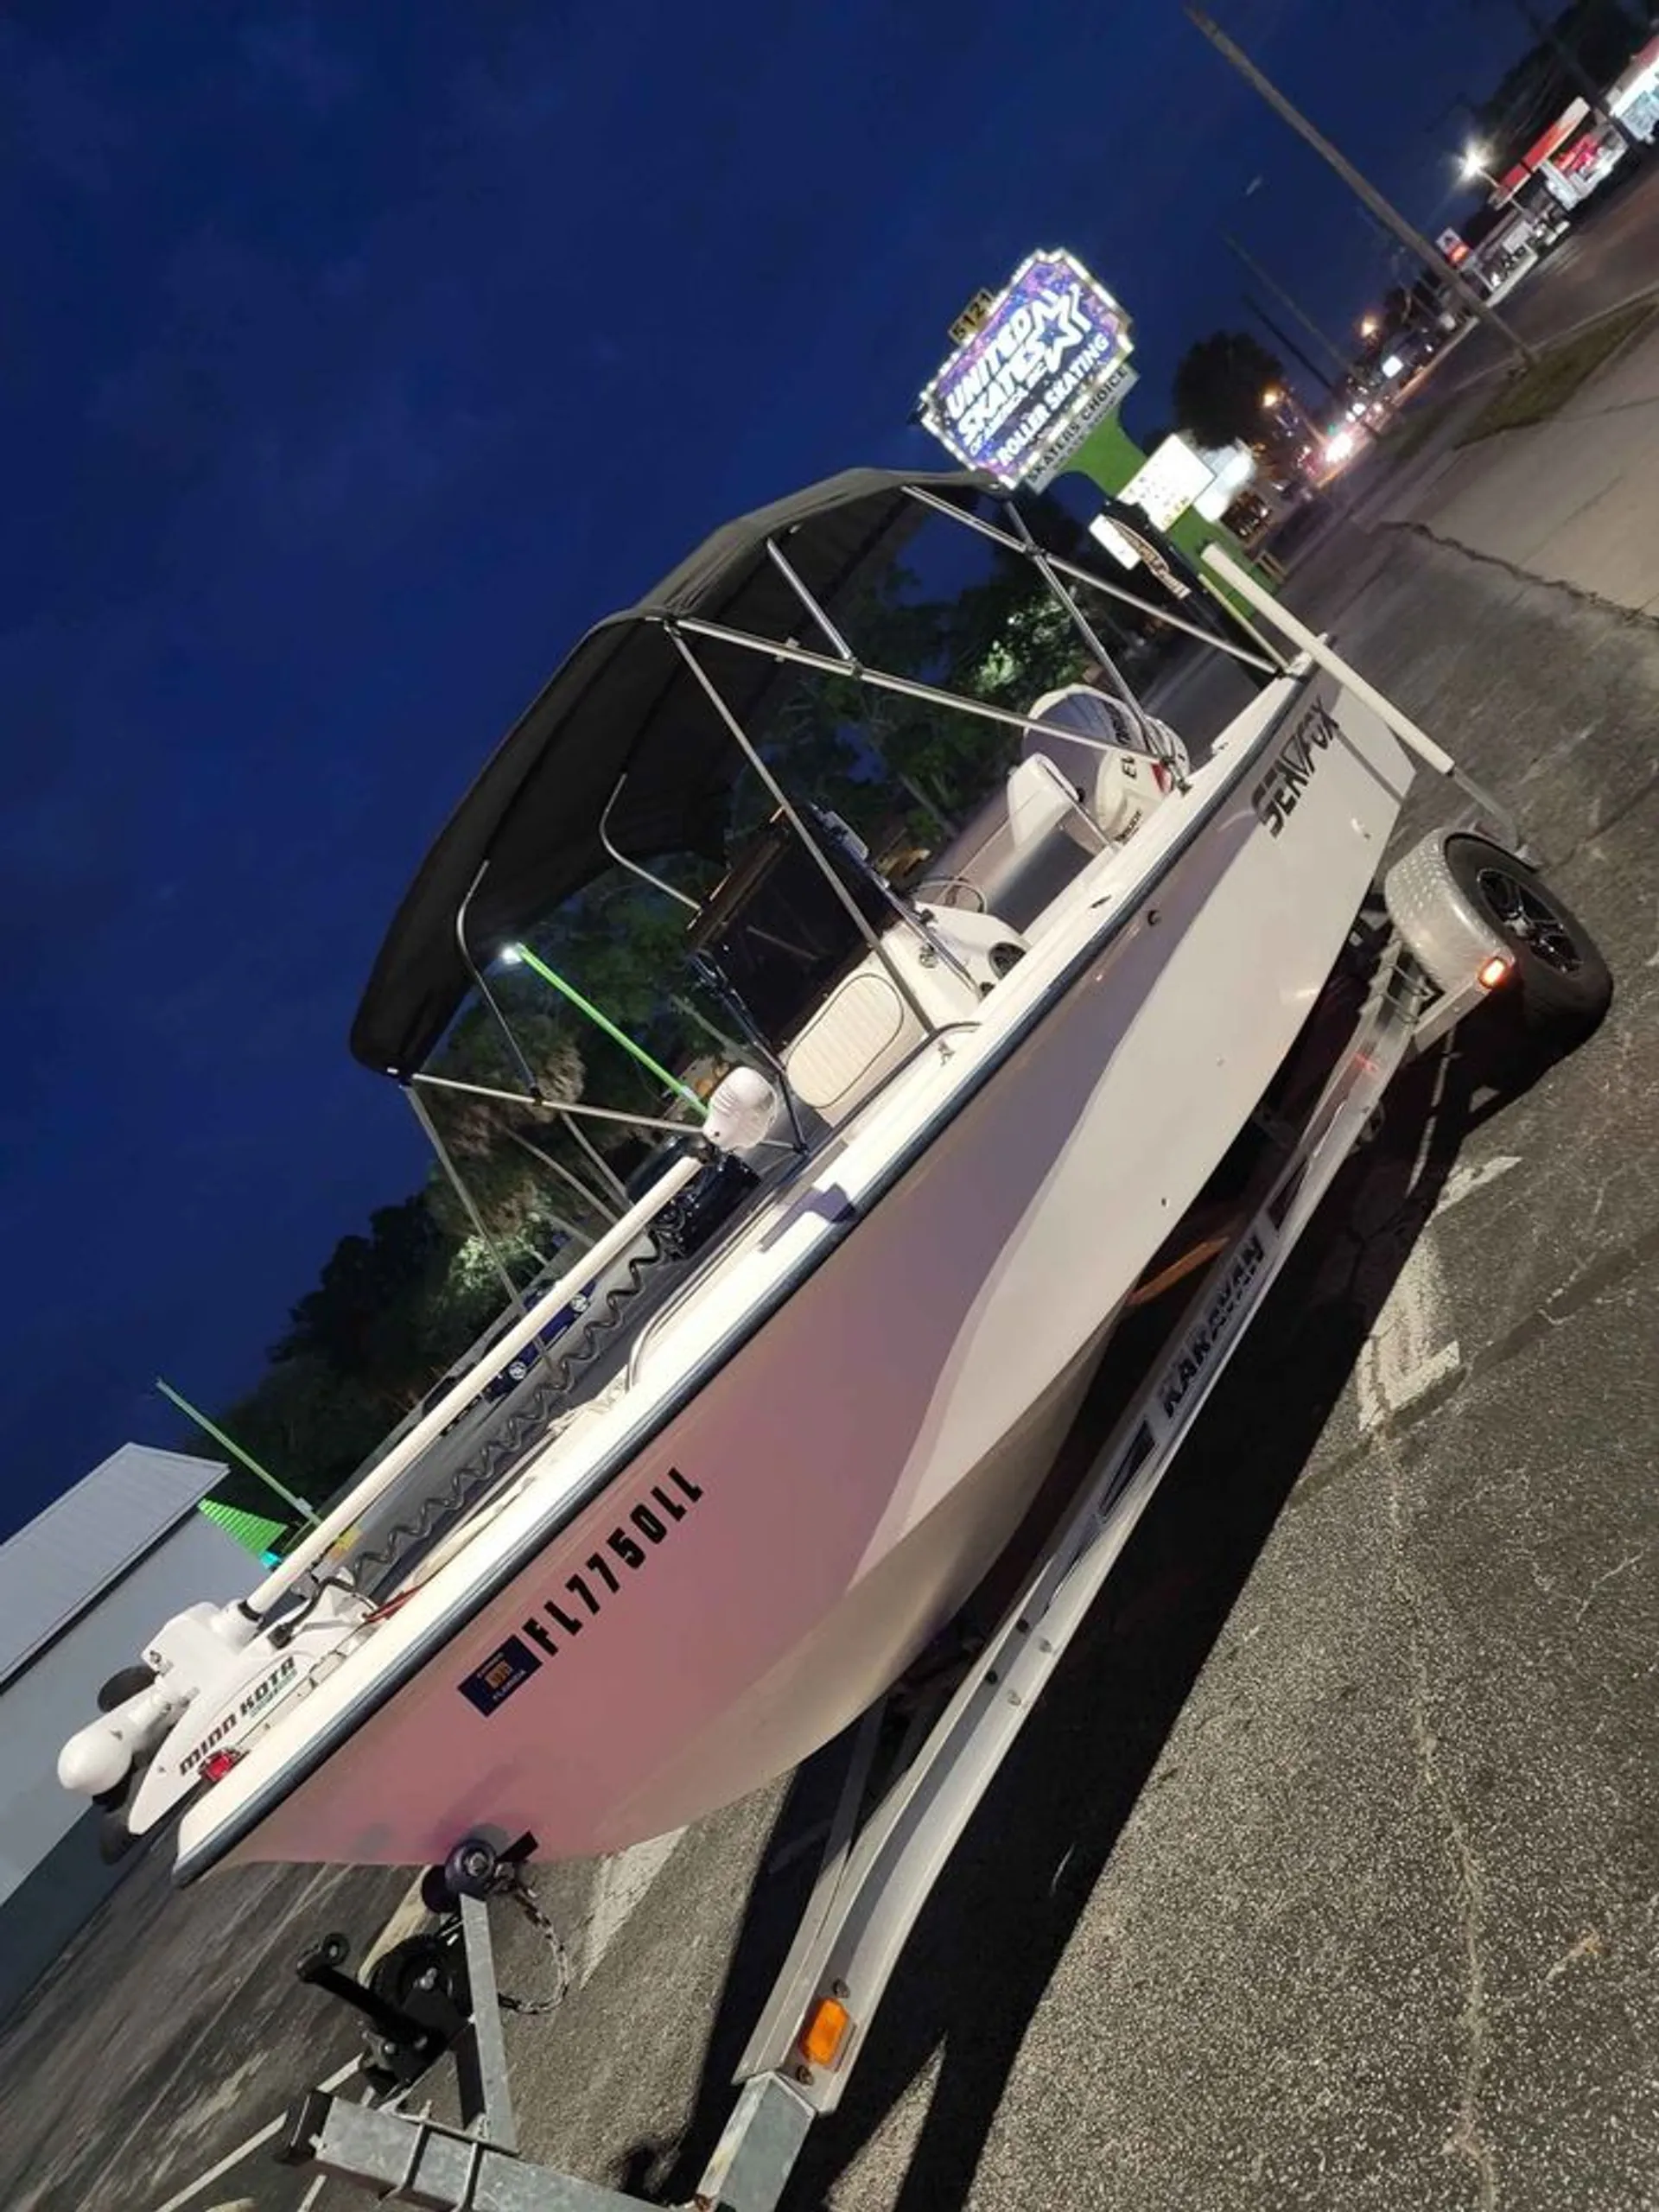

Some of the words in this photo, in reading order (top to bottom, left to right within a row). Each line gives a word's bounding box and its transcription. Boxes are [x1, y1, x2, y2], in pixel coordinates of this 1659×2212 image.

[946, 306, 1033, 420] UNITED
[951, 294, 991, 340] 5121
[957, 330, 1046, 448] SKATES
[996, 403, 1051, 467] ROLLER
[1044, 333, 1109, 410] SKATING
[1082, 367, 1128, 422] CHOICE
[179, 1713, 238, 1777] MINN
[239, 1656, 296, 1717] KOTA
